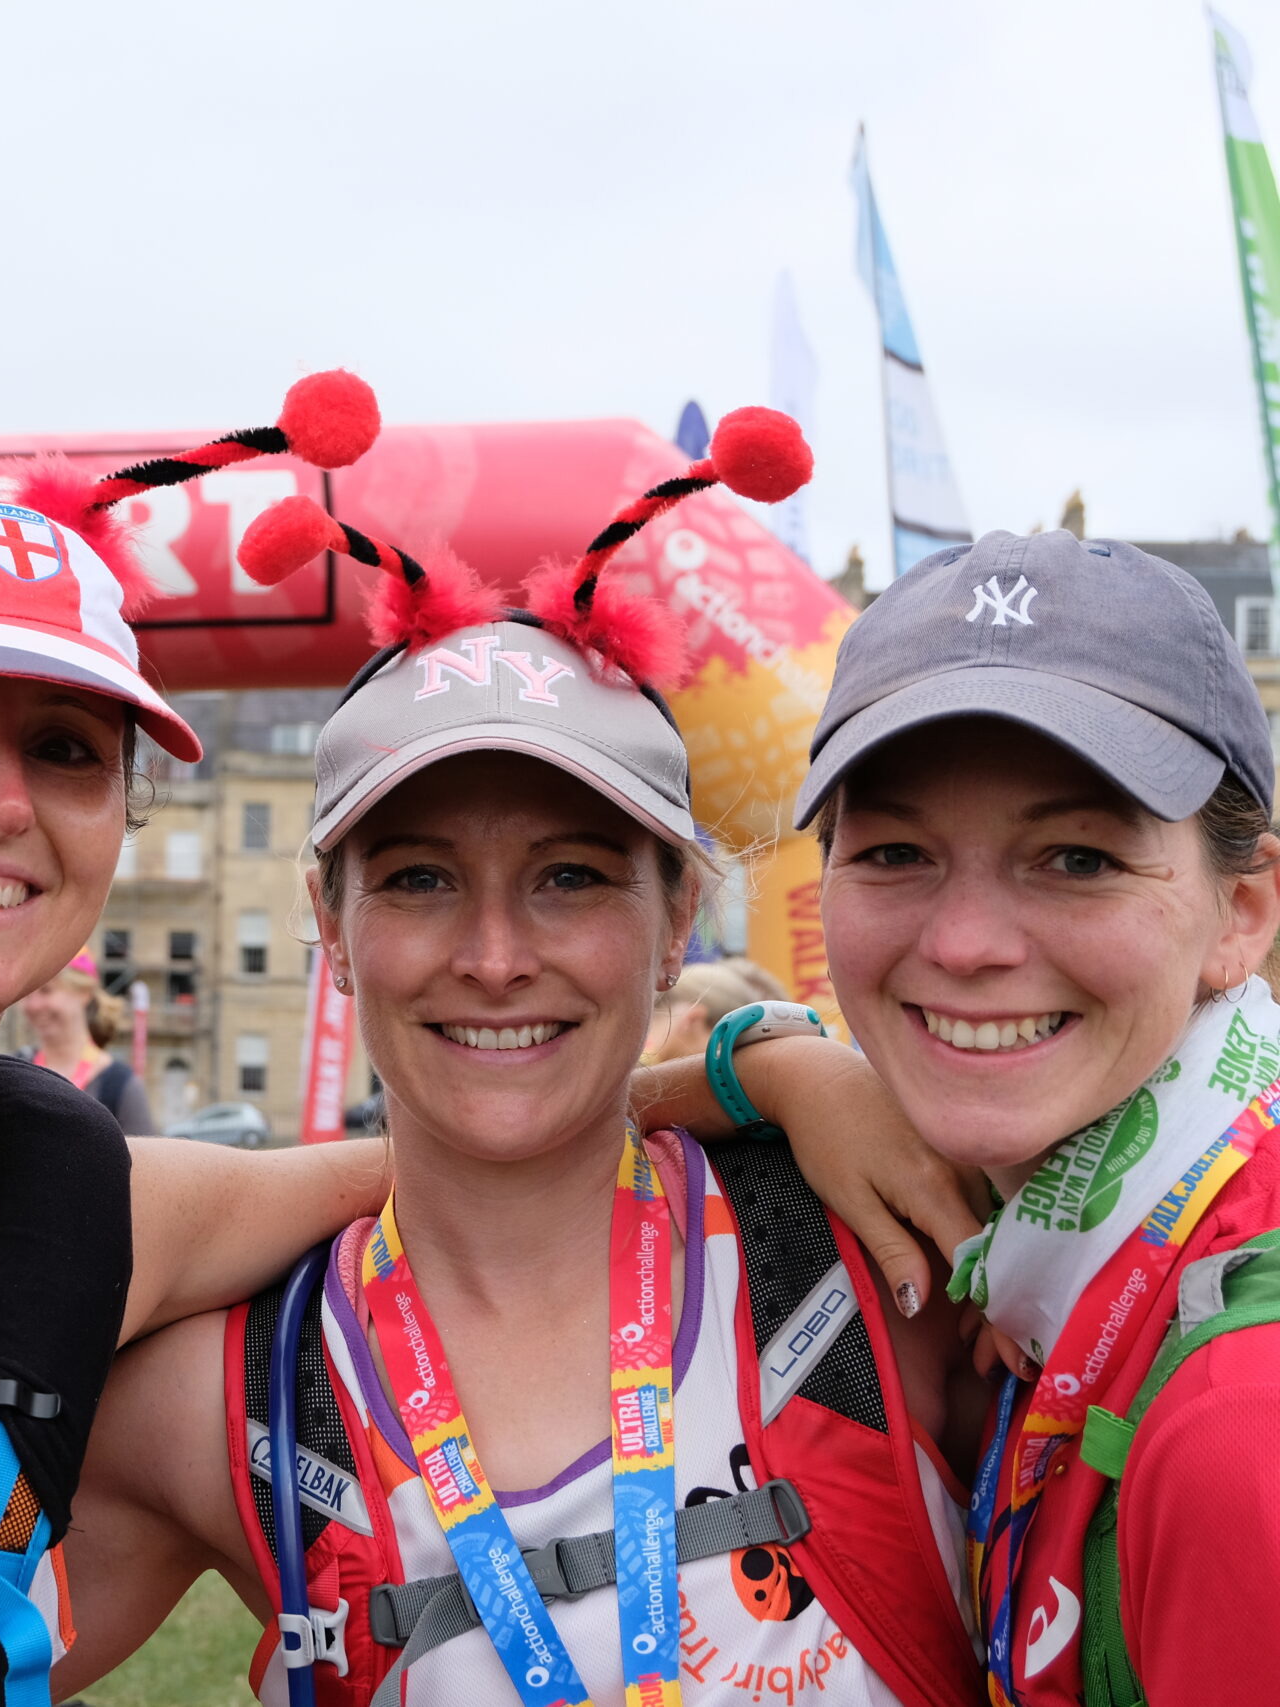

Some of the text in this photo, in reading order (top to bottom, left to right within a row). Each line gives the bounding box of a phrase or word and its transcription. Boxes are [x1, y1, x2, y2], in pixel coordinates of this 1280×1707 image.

[965, 574, 1039, 625] NY
[413, 635, 576, 708] NY
[1105, 1156, 1128, 1175] RUN
[1124, 1141, 1140, 1159] OR
[1057, 1175, 1089, 1216] WAY
[636, 1221, 659, 1326] actionchallenge
[395, 1291, 437, 1388] actionchallenge
[770, 1289, 847, 1377] LOBO
[1081, 1267, 1147, 1385] actionchallenge
[617, 1391, 644, 1451] ULTRA
[640, 1389, 660, 1448] CHALLENGE
[251, 1435, 352, 1513] CELBAK
[424, 1447, 460, 1506] ULTRA
[443, 1441, 474, 1494] CHALLENGE
[642, 1507, 665, 1635] actionchallenge
[488, 1547, 553, 1665] actionchallenge
